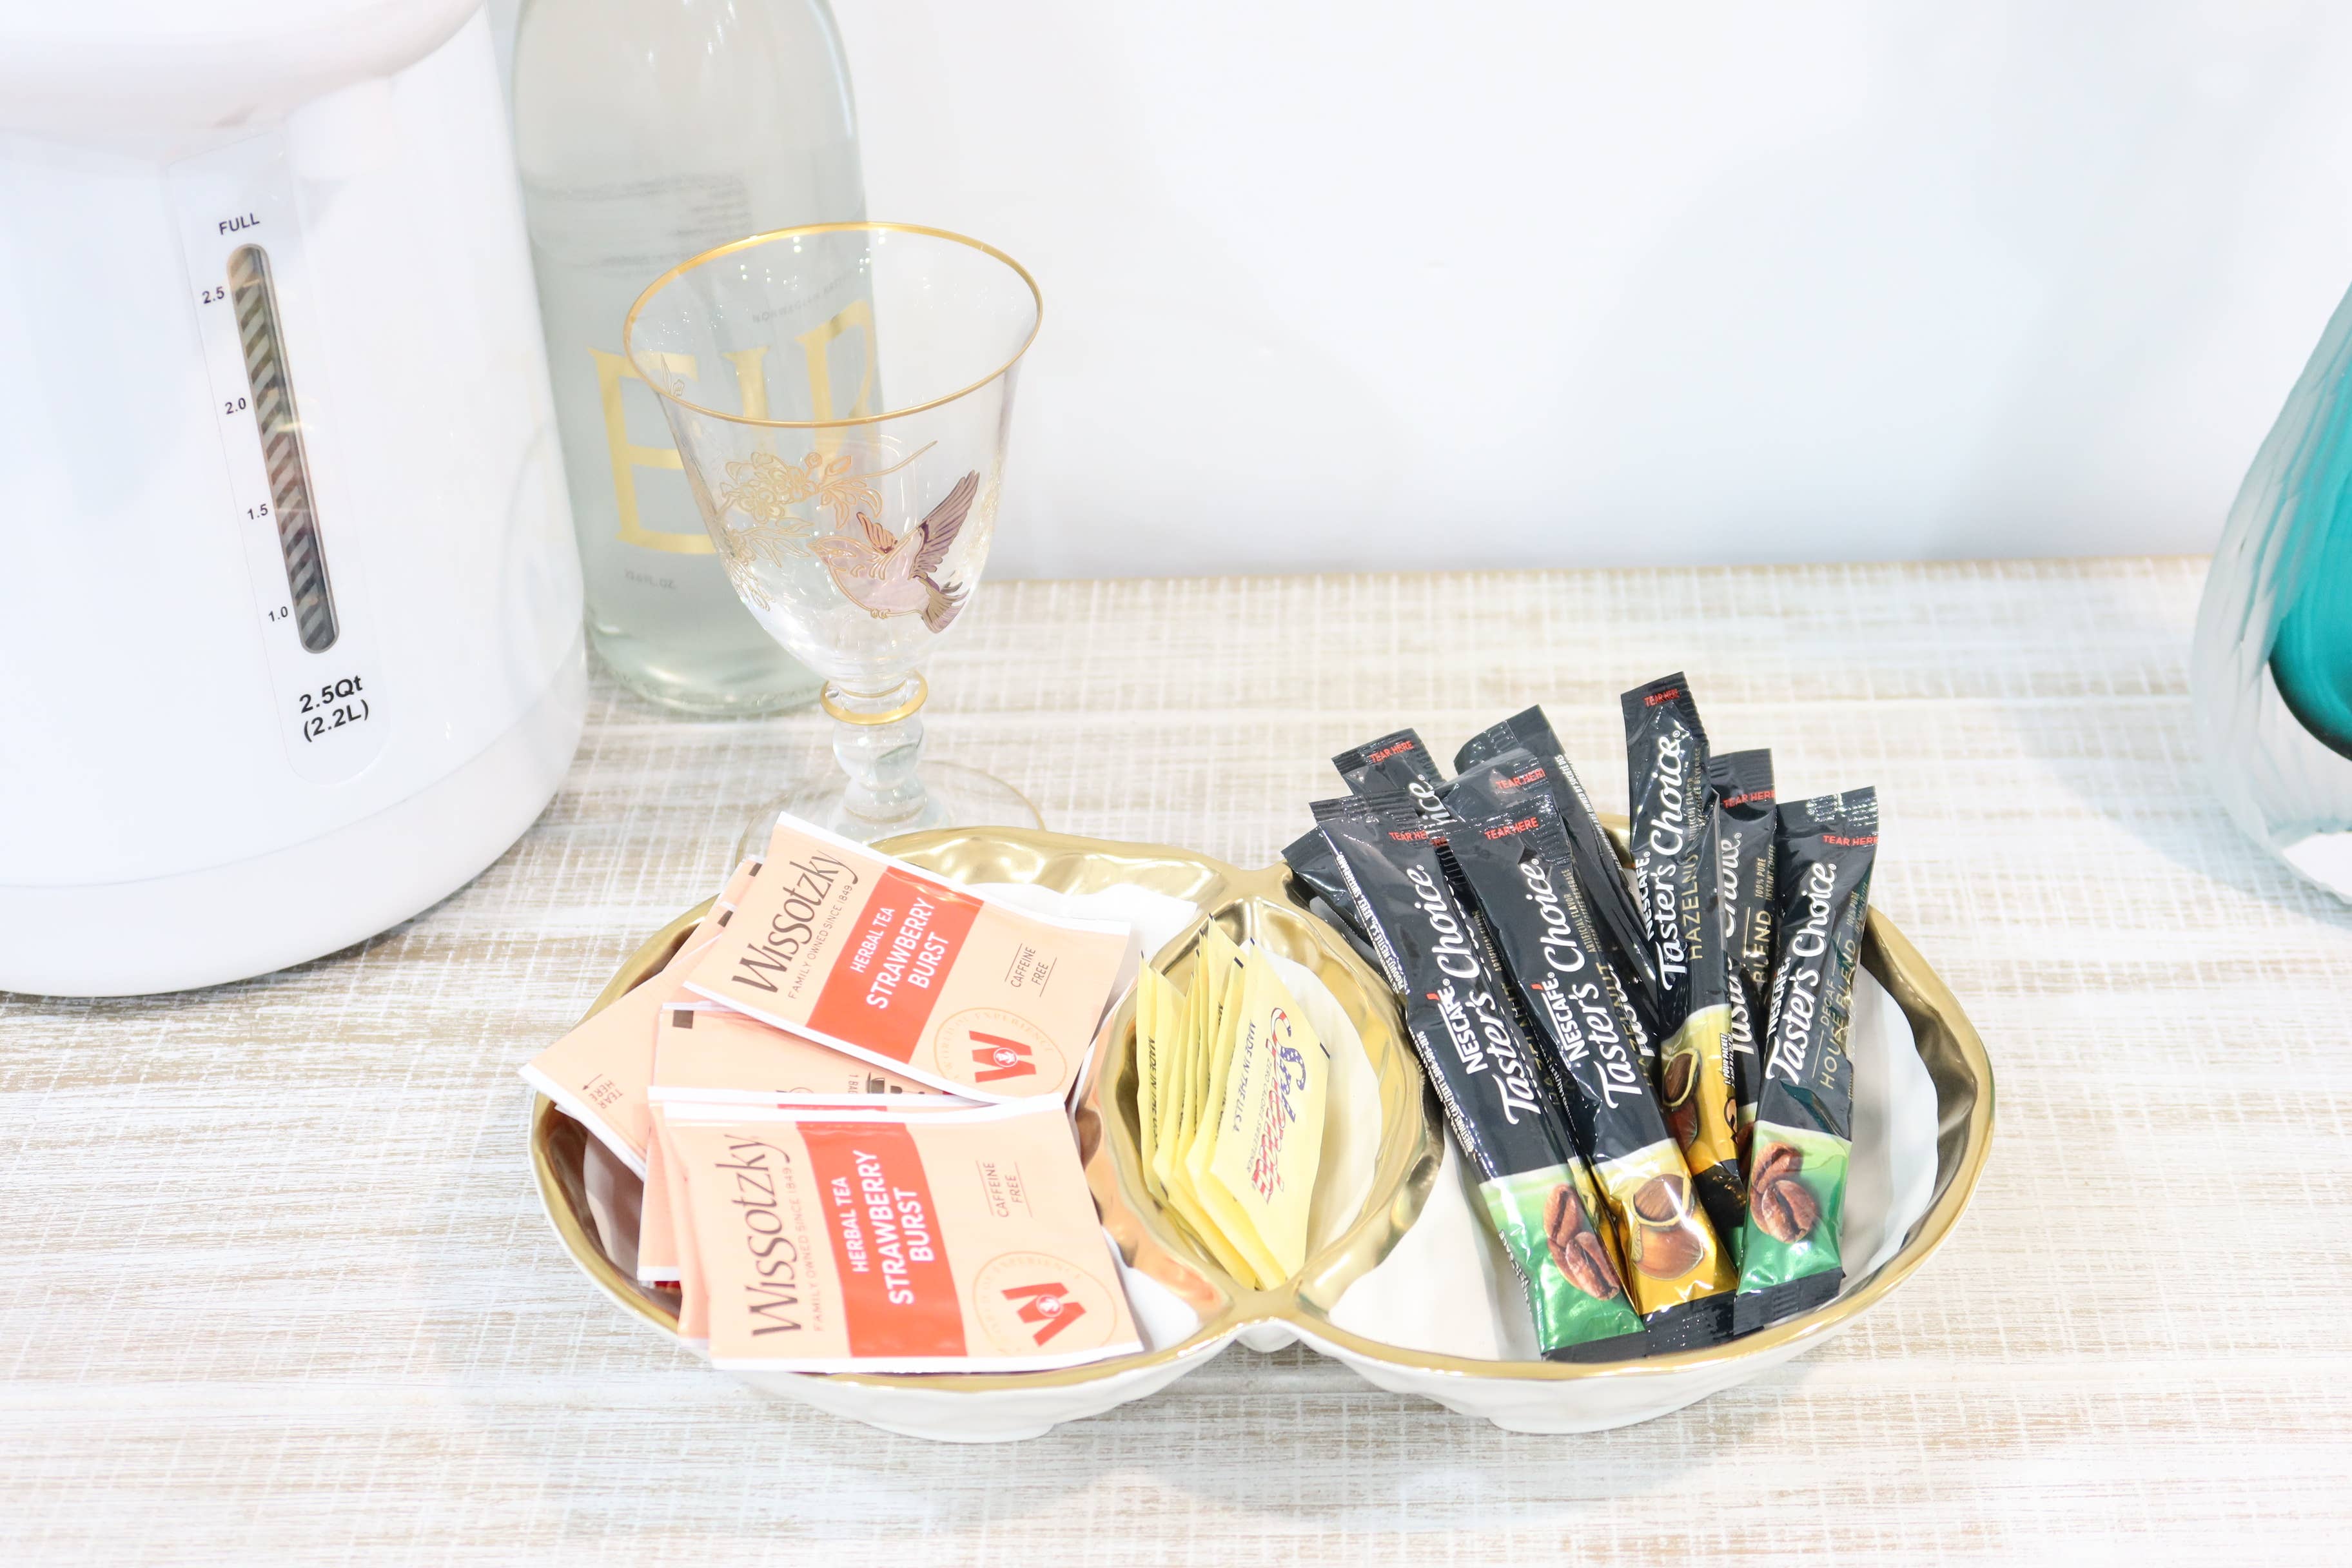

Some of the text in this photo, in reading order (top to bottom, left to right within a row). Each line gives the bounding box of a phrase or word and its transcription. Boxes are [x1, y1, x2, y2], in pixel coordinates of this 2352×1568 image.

[218, 213, 260, 235] FULL
[202, 286, 224, 304] 2.5
[224, 397, 247, 415] 2.0
[247, 504, 269, 520] 1.5
[268, 606, 288, 622] 1.0
[299, 675, 364, 714] 2.5Qt
[1643, 693, 1664, 707] TEAR
[303, 699, 369, 743] (2.2L)
[1369, 741, 1414, 763] TEAR HERE
[1495, 776, 1522, 790] TEAR
[1723, 794, 1749, 808] TEAR
[1388, 830, 1413, 841] TEAR
[1484, 817, 1539, 841] TEAR HERE
[1823, 835, 1850, 846] TEAR
[1650, 736, 1687, 991] Taster's Choice
[1754, 857, 1766, 897] 100% PURE
[1849, 890, 1859, 908] PURE
[731, 850, 858, 994] Wissotzky
[787, 883, 853, 1000] FAMILY OWNED SINCE 1849
[850, 906, 896, 974] HERBAL TEA
[1563, 892, 1596, 954] ARTIFICIAL FLAVOR
[866, 897, 934, 1010] STRAWBERRY
[908, 932, 949, 989] BURST
[1752, 910, 1772, 983] BLEND
[1010, 946, 1036, 988] CAFFEINE
[1031, 962, 1049, 986] FREE
[1383, 950, 1407, 986] PRODUITS
[1520, 862, 1642, 1109] Taster's Choice
[1765, 862, 1836, 1085] Taster's Choice
[1407, 867, 1541, 1125] Taster's Choice
[1819, 982, 1837, 1028] DECAF
[1820, 938, 1857, 1090] HOUSE BLEND
[1148, 1036, 1156, 1072] MADE
[1243, 1020, 1255, 1057] MADE
[1416, 1030, 1446, 1083] 1-800-505-2876
[1720, 1033, 1729, 1059] PACKET
[1241, 1056, 1250, 1073] IN
[1237, 1073, 1248, 1100] THE
[1252, 1008, 1306, 1205] Splenda
[1438, 1081, 1460, 1117] CALL/TEXT
[1245, 1058, 1272, 1172] ZERO CALORIE SWEETENER
[1452, 1114, 1475, 1153] QUESTIONS
[983, 1161, 1010, 1218] CAFFEINE
[1005, 1175, 1023, 1204] FREE
[714, 1133, 802, 1337] Wissotzky
[830, 1177, 869, 1273] HERBAL TEA
[852, 1150, 915, 1305] STRAWBERRY
[893, 1186, 935, 1262] BURST
[781, 1166, 826, 1333] FAMILY OWNED SINCE 1849
